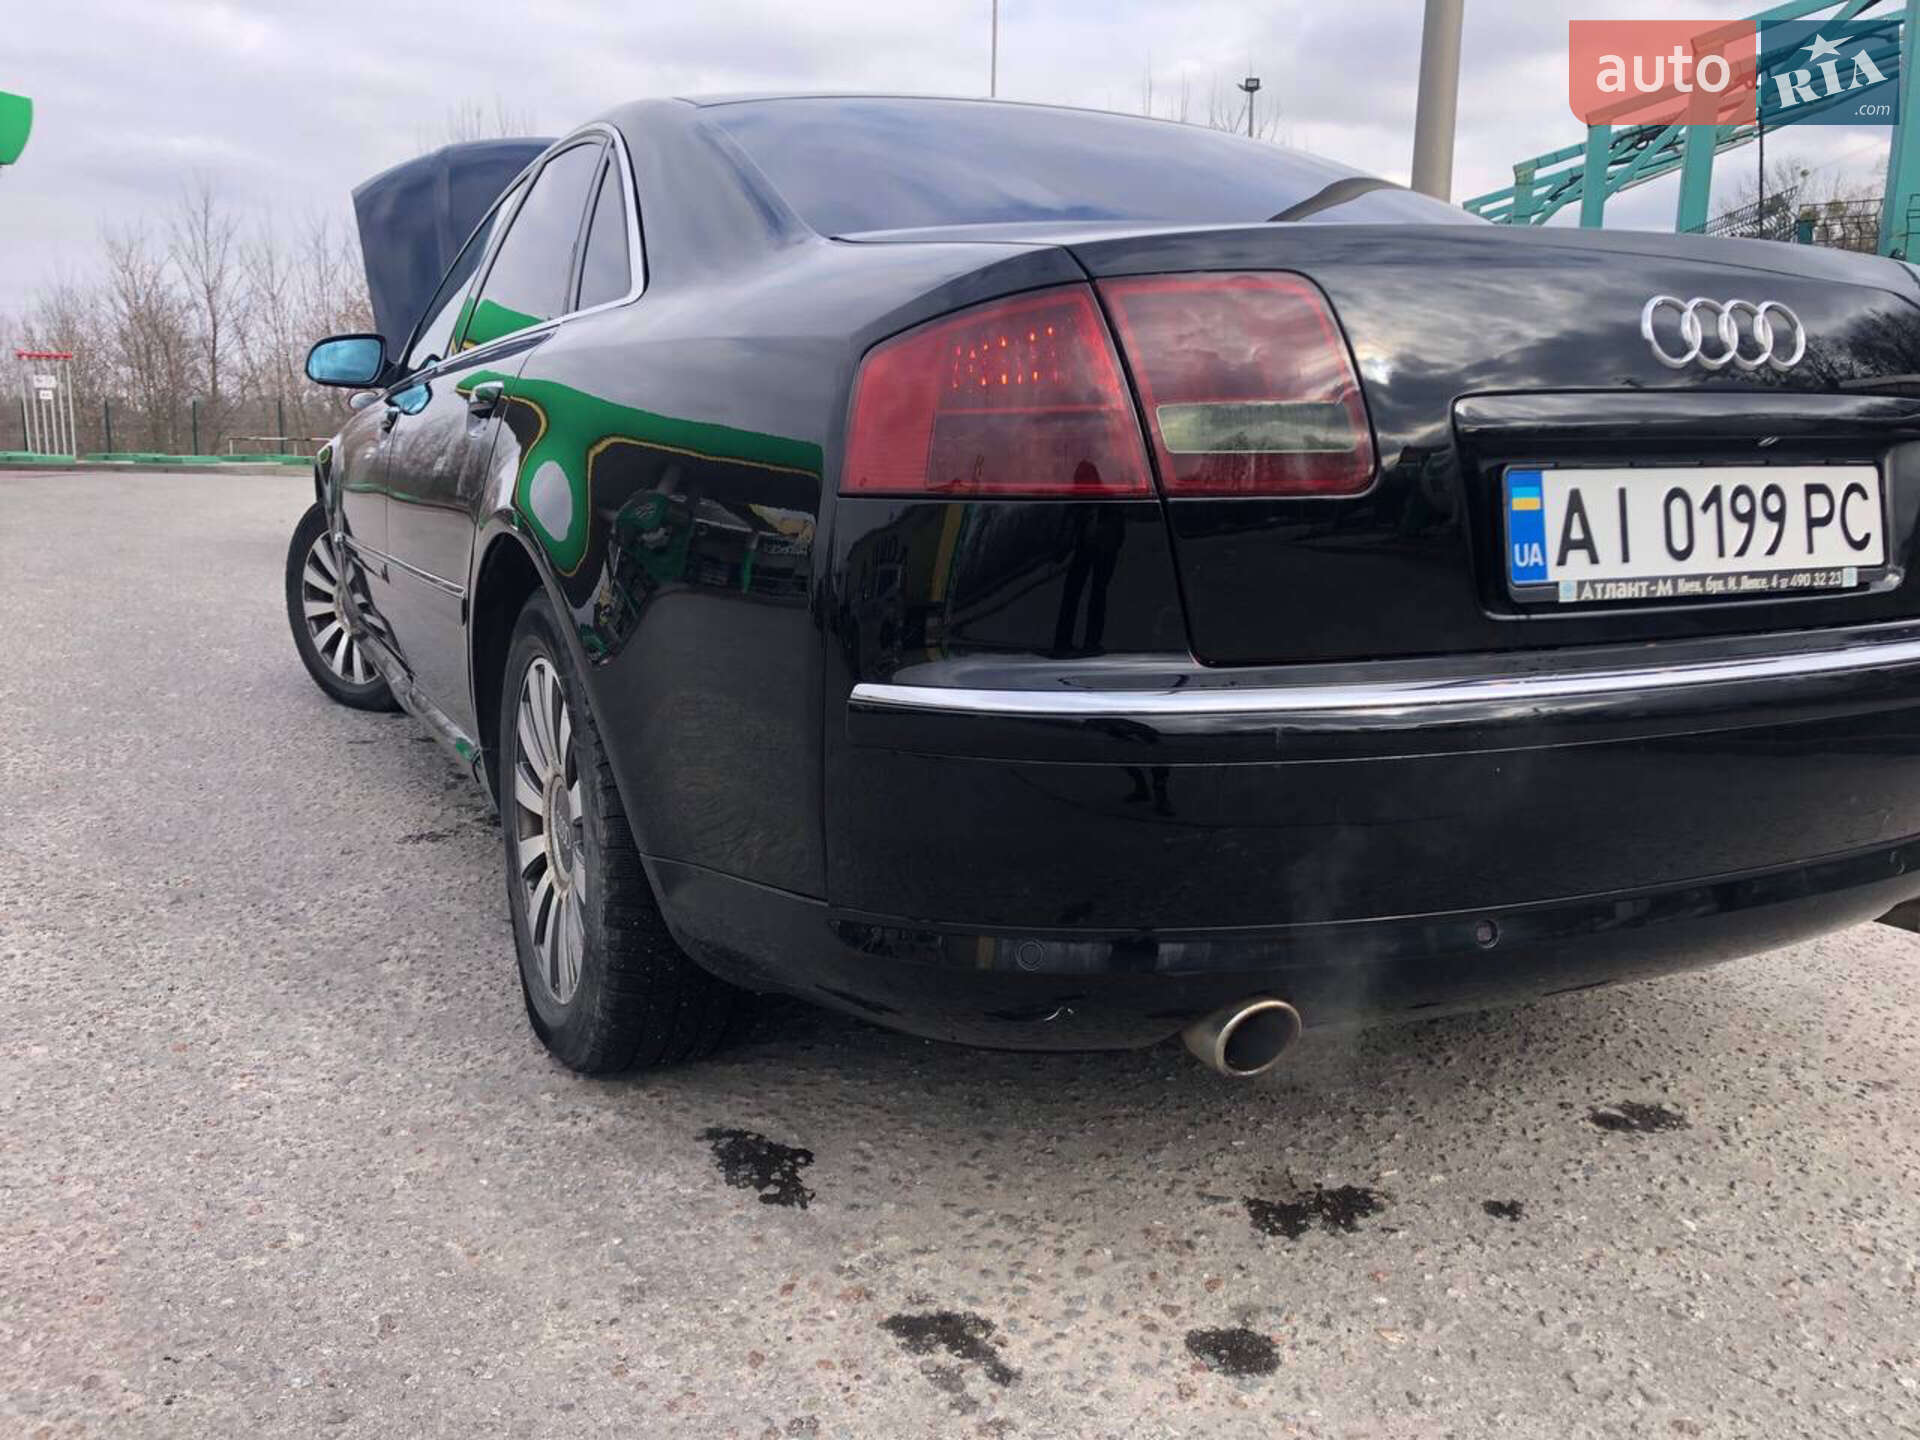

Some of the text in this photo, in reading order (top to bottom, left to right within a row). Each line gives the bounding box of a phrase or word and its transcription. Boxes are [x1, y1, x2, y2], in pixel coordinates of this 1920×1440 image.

[1556, 482, 1872, 567] AI 0199 PC
[1514, 543, 1545, 568] UA
